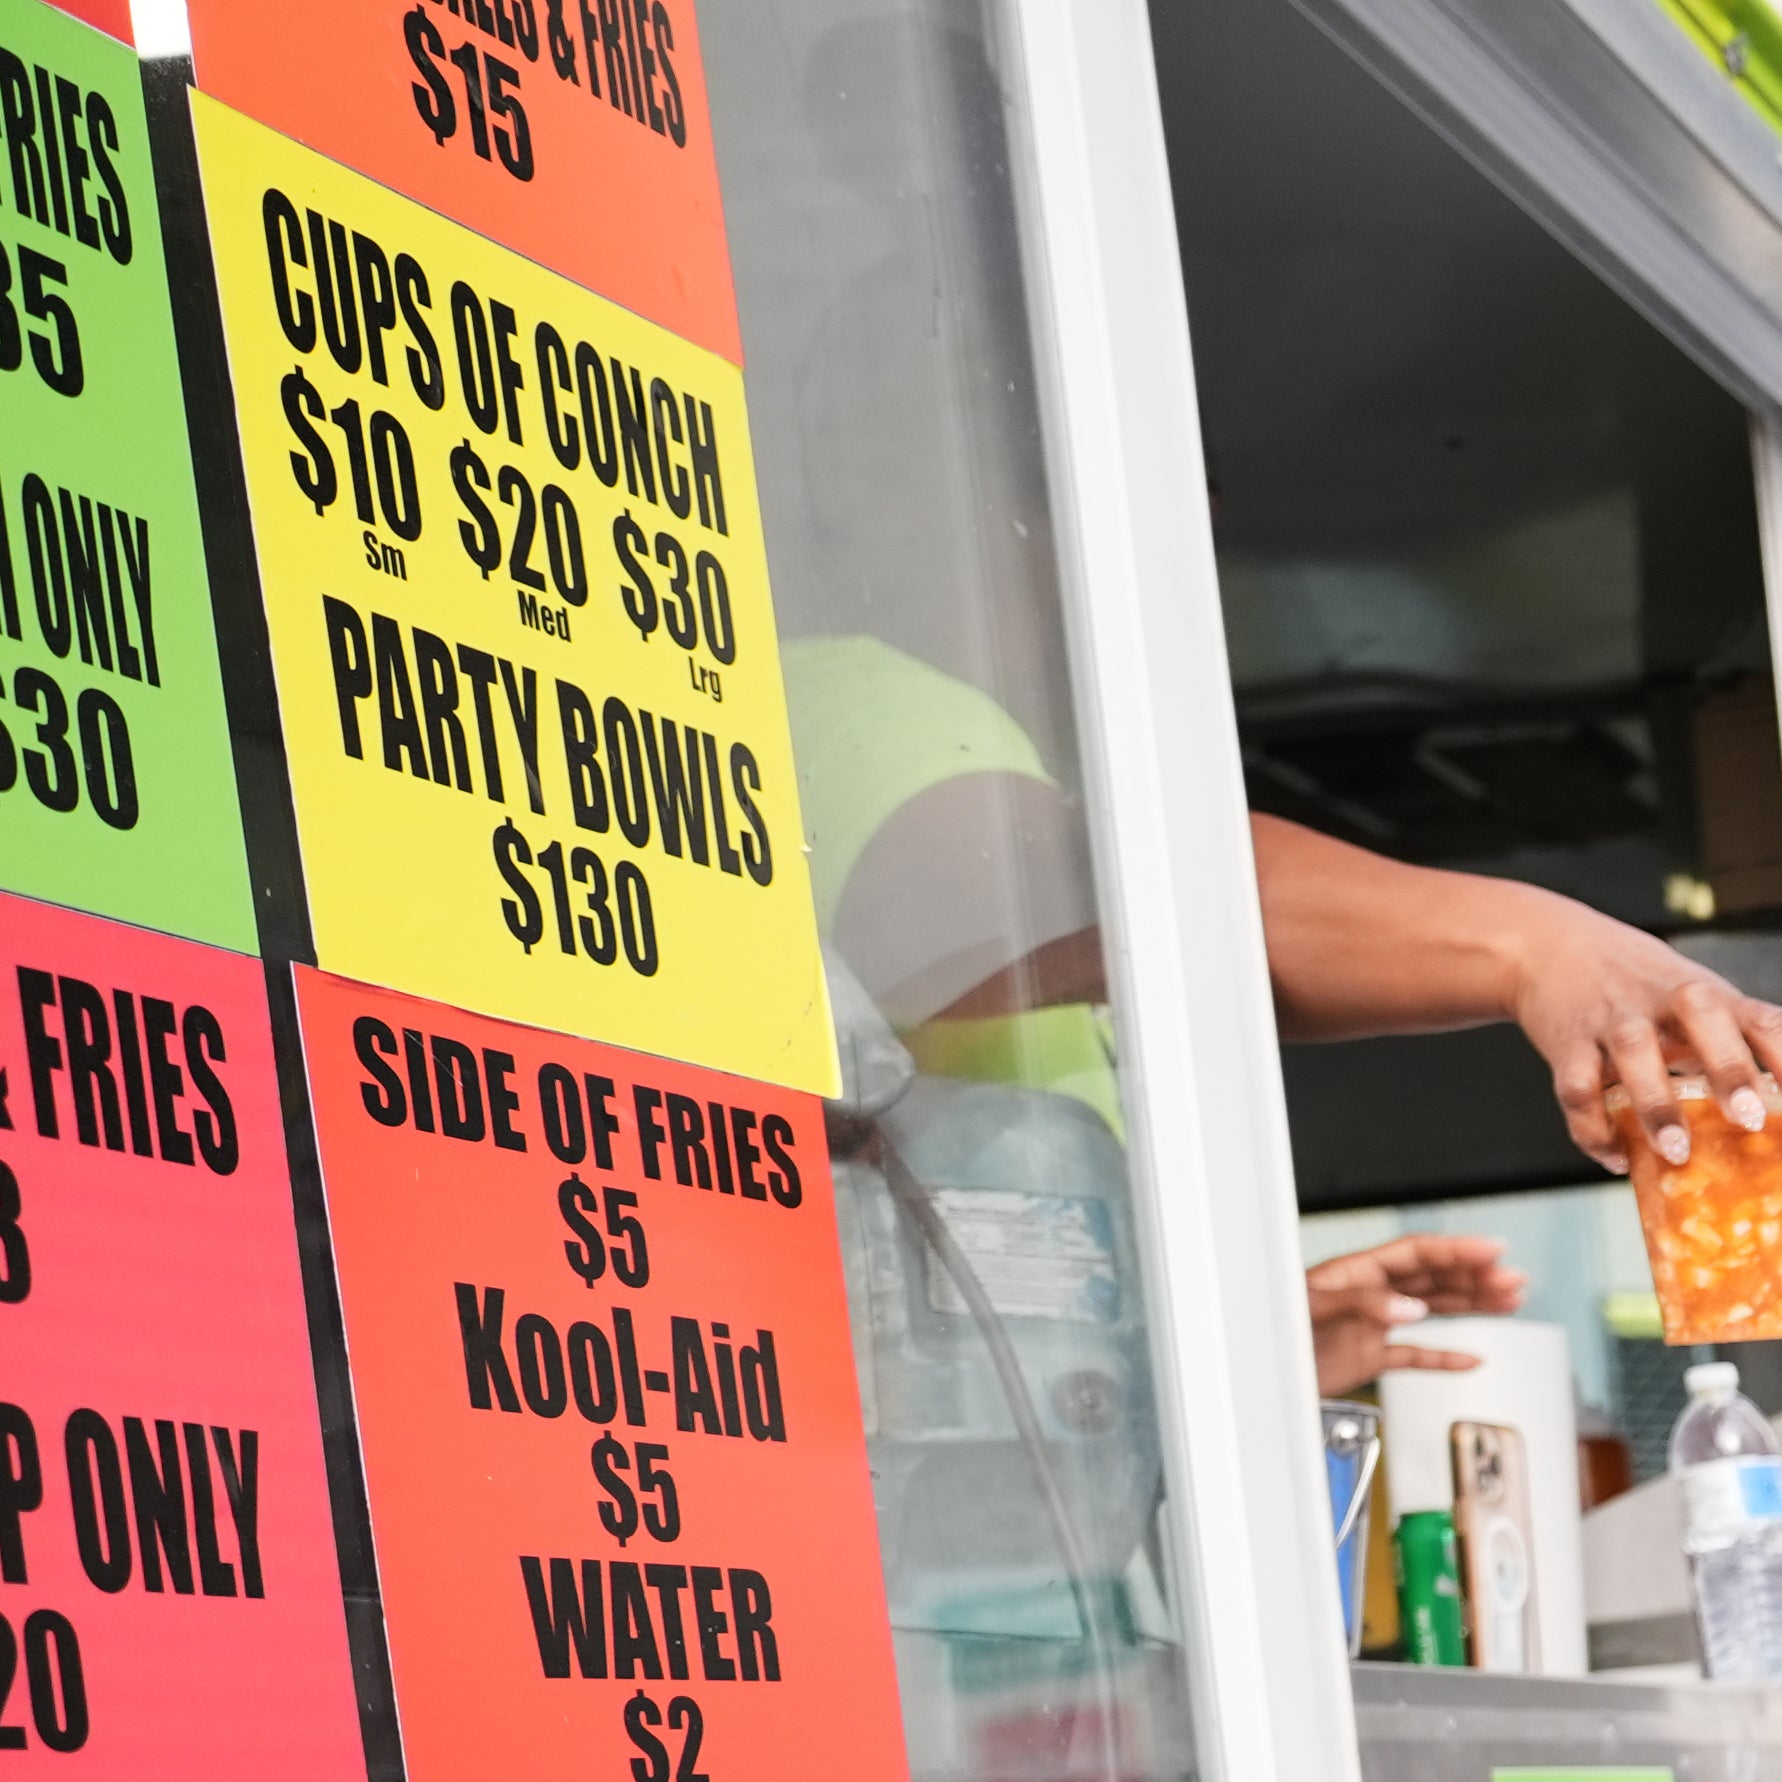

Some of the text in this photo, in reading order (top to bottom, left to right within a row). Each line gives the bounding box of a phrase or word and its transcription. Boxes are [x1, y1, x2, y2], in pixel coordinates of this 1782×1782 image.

[0, 46, 133, 266] RIES
[403, 3, 535, 183] $15
[579, 0, 686, 149] FRIES
[262, 188, 729, 537] CUPS OF CONCH
[21, 472, 161, 689] ONLY
[280, 365, 736, 666] $10 $20 $30
[363, 530, 722, 703] Sm Med Lrg
[0, 666, 139, 832] 30
[322, 594, 773, 888] PARTY BOWLS
[492, 817, 658, 977] $130
[16, 965, 240, 1177] FRIES
[353, 1016, 803, 1210] SIDE OF FRIES
[557, 1173, 650, 1289] $5
[454, 1283, 787, 1443] Kool-Aid
[64, 1408, 266, 1600] ONLY
[591, 1431, 681, 1547] $5
[519, 1556, 782, 1682] WATER
